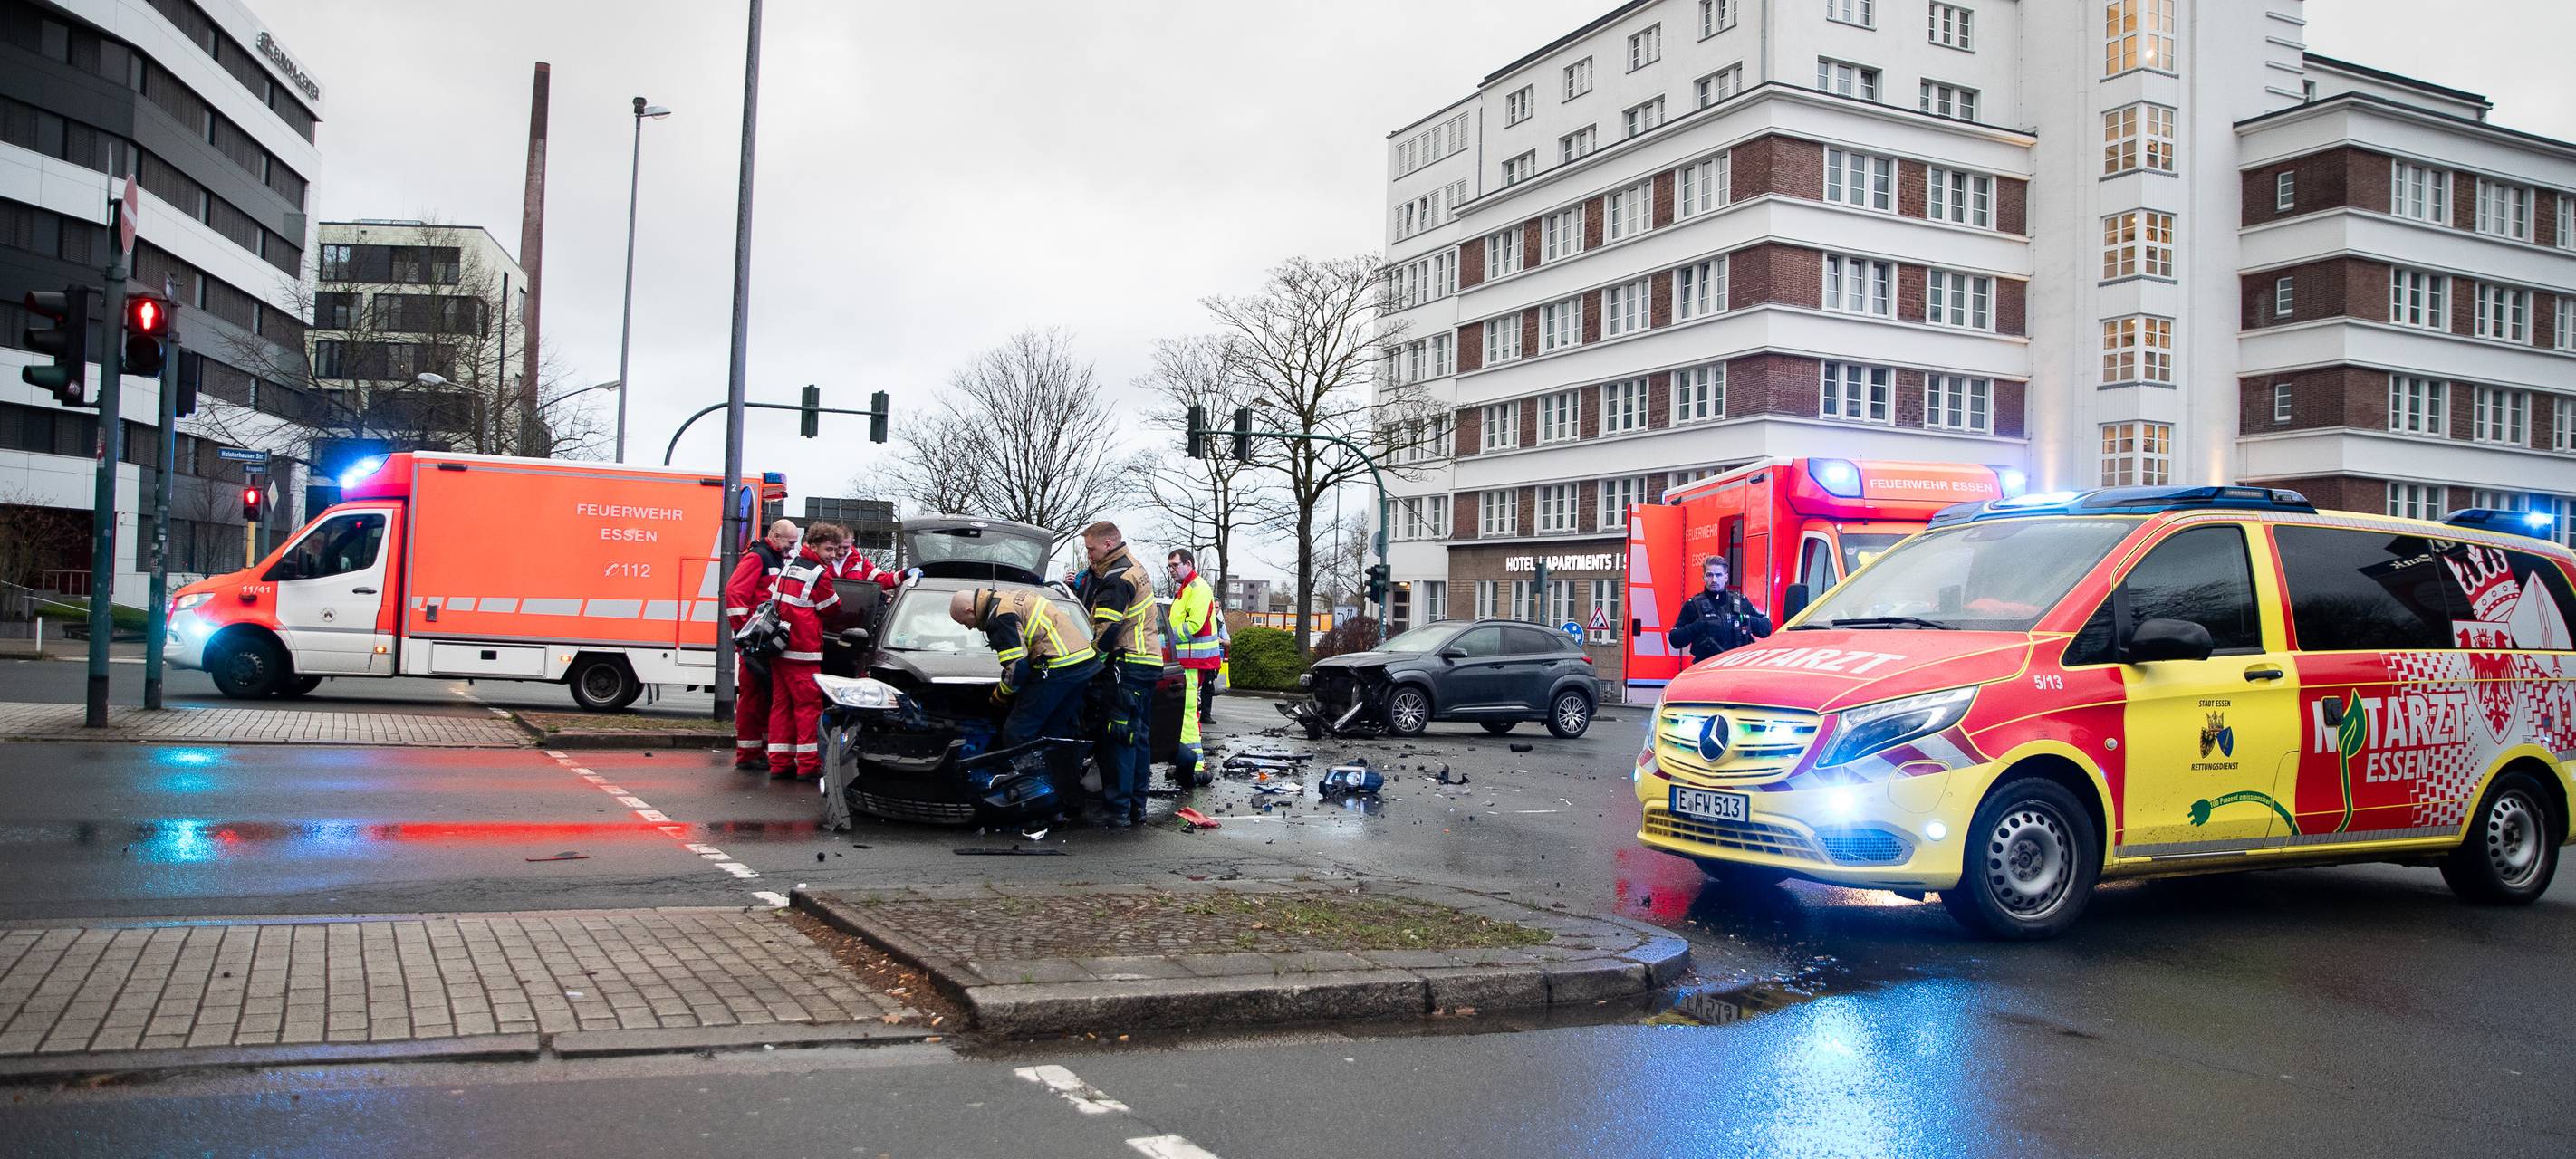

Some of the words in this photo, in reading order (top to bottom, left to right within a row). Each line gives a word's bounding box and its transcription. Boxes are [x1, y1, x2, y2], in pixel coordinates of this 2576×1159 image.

[731, 484, 737, 493] 2
[1870, 478, 1948, 490] FEUERWEHR
[1952, 481, 1994, 493] ESSEN
[577, 503, 683, 521] FEUERWEHR
[601, 528, 658, 542] ESSEN
[1686, 522, 1718, 541] FEUERWEHR
[1505, 556, 1536, 572] HOTEL
[1546, 553, 1612, 571] APARTMENTS
[621, 563, 650, 578] 112
[242, 585, 271, 594] 11/41
[1700, 647, 1908, 675] NOTARZT
[2033, 675, 2064, 690] 5/13
[2191, 762, 2239, 771] RETTUNGSDIENST
[2366, 750, 2430, 783] ESSEN
[1714, 796, 1740, 818] 513
